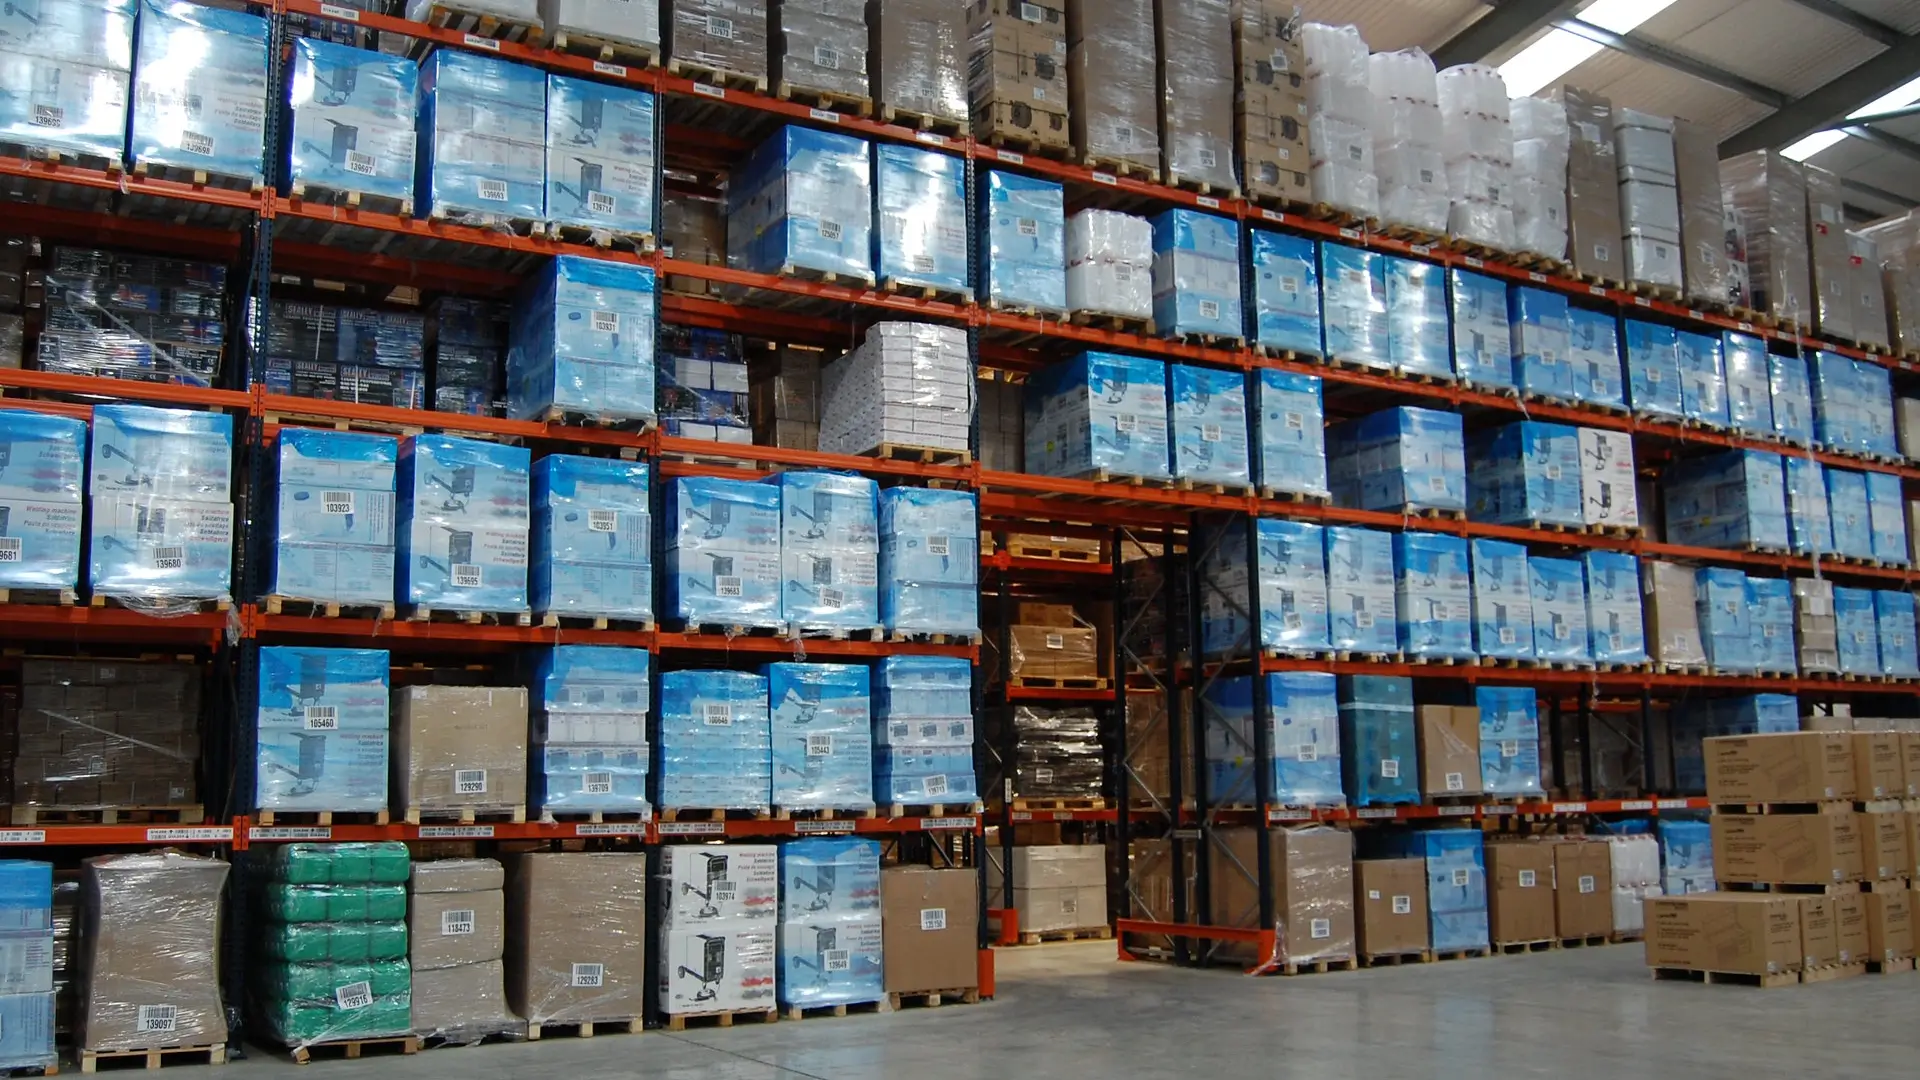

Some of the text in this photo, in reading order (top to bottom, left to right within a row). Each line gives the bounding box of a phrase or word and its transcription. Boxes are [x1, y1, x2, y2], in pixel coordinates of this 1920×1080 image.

[350, 162, 373, 174] 139697
[592, 202, 612, 213] 139714
[596, 321, 617, 331] 103931
[326, 503, 350, 513] 103923
[156, 558, 182, 569] 139680
[310, 718, 335, 729] 105460
[460, 782, 483, 792] 129290
[588, 783, 609, 793] 139709
[715, 892, 735, 901] 103974
[447, 922, 471, 934] 118473
[576, 975, 599, 986] 129283
[343, 996, 368, 1009] 129916
[145, 1018, 173, 1030] 139097
